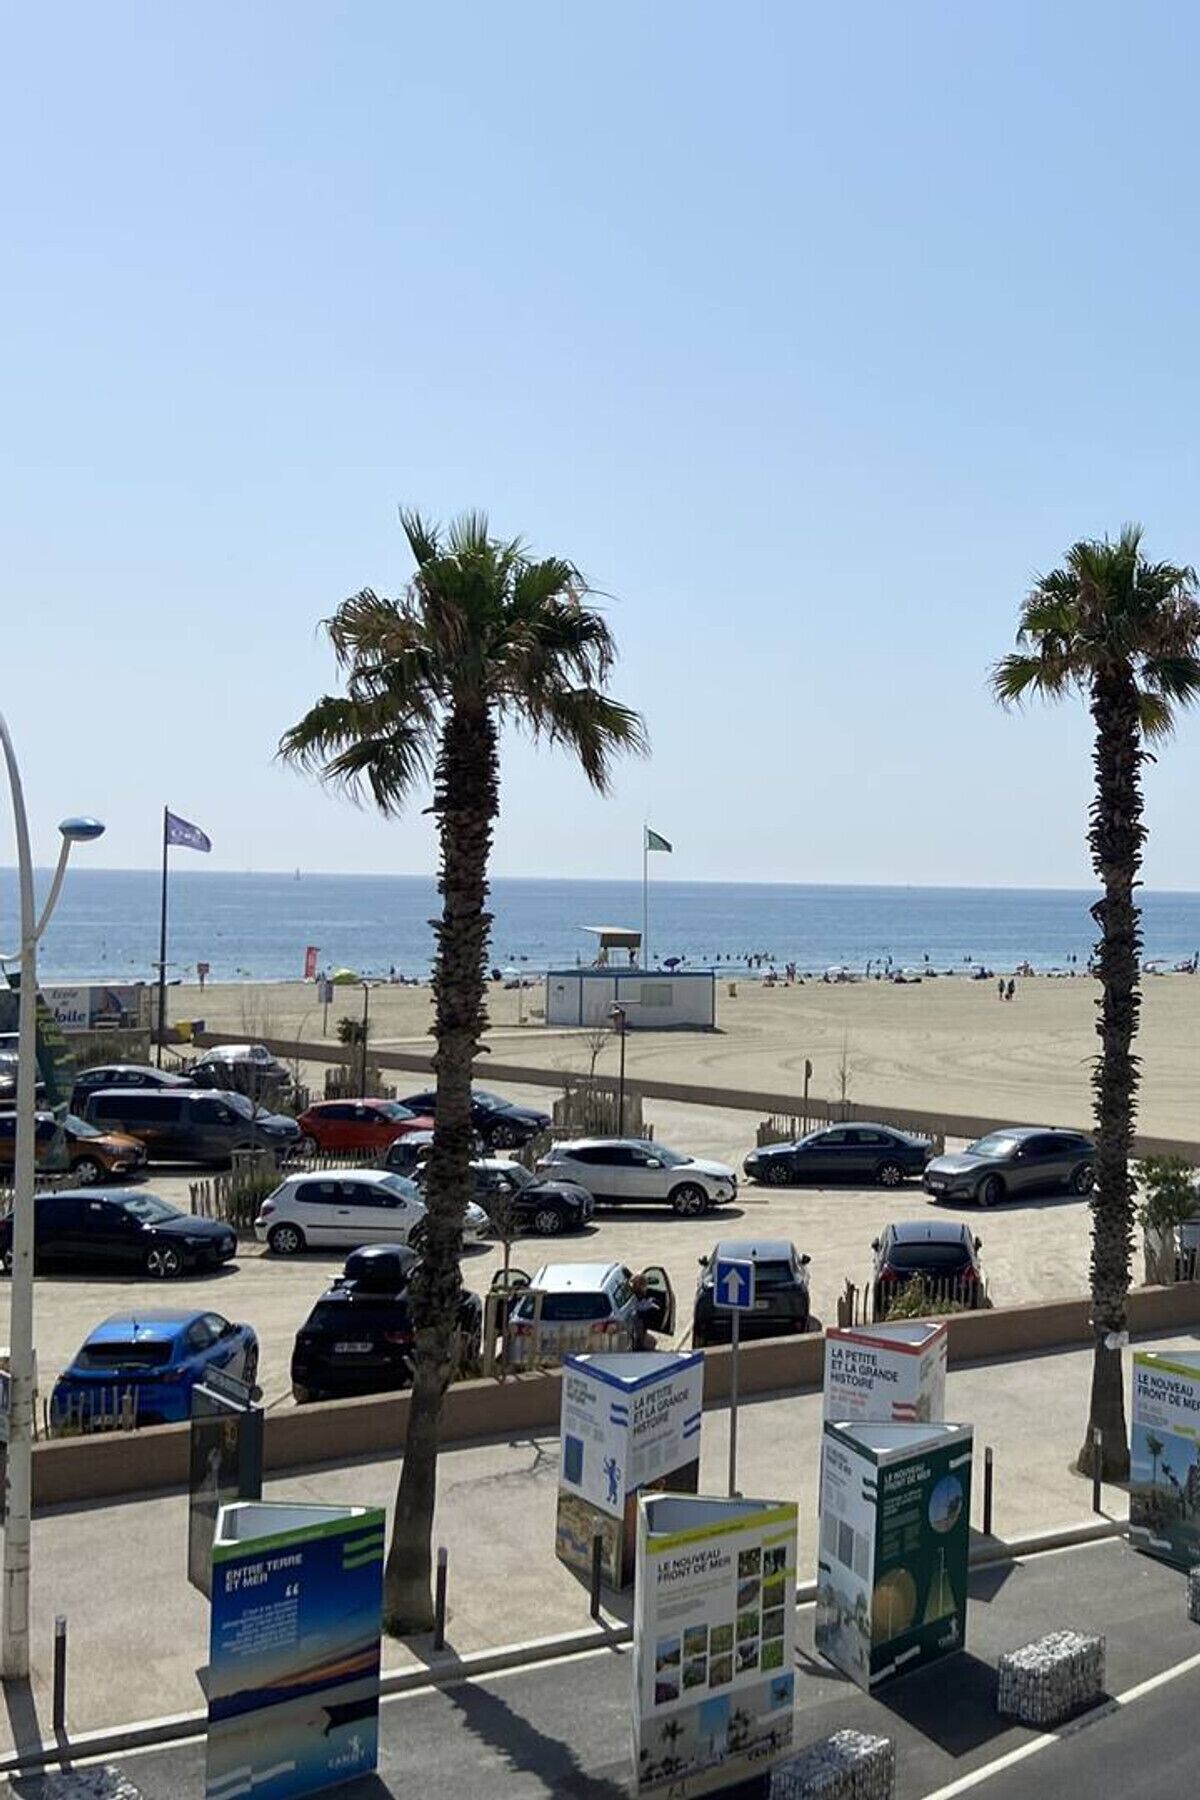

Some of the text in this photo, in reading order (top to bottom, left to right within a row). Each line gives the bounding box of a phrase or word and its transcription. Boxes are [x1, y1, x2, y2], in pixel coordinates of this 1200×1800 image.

[832, 1348, 878, 1366] LA PETITE
[830, 1372, 874, 1390] HISTOIRE
[831, 1360, 899, 1383] ET LA GRANDE
[1138, 1373, 1194, 1398] LE NOUVEAU
[1138, 1386, 1167, 1402] FRONT
[1168, 1393, 1181, 1407] DE
[633, 1396, 645, 1411] LA
[633, 1388, 690, 1423] ET LA GRANDE
[225, 1553, 303, 1580] ENTRE TERRE
[657, 1555, 731, 1583] FRONT DE MER
[658, 1548, 721, 1573] LE NOUVEAU
[225, 1572, 268, 1593] ET MER
